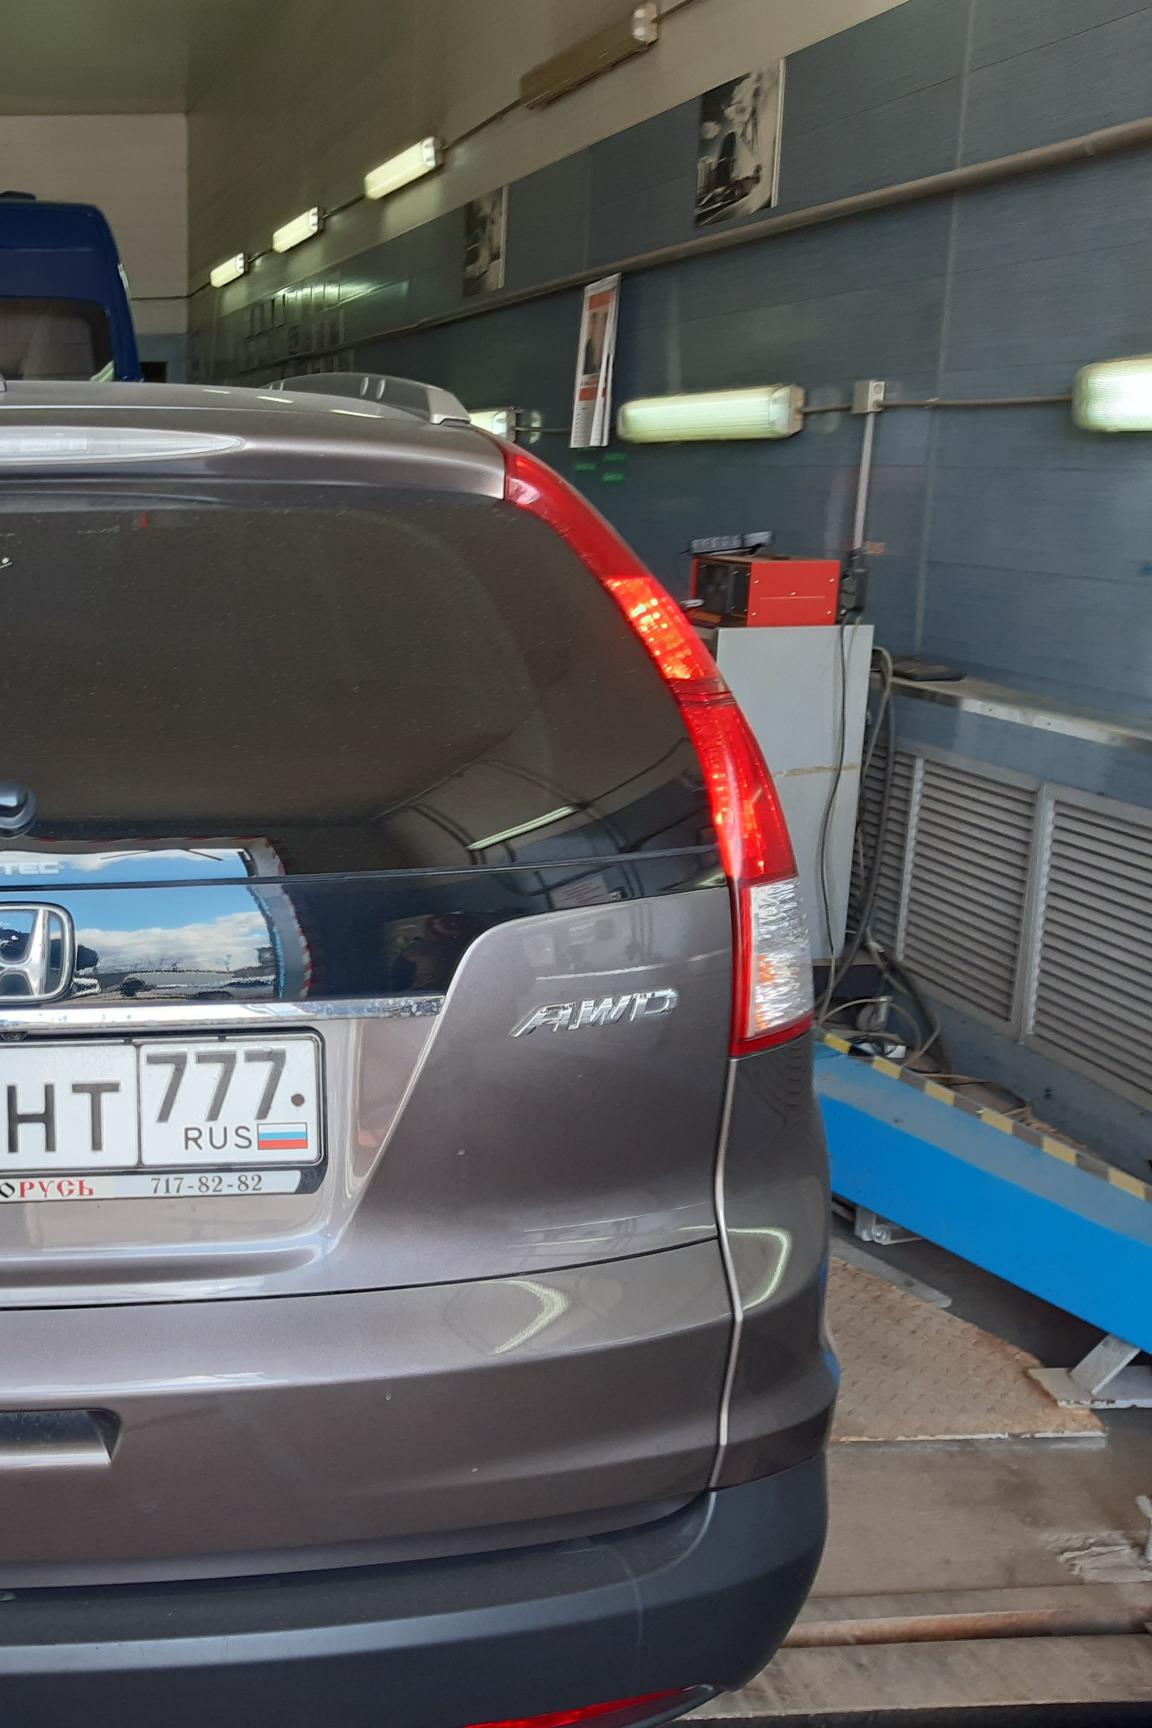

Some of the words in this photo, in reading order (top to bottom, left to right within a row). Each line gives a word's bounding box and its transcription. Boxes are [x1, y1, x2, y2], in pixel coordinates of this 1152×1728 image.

[508, 988, 679, 1038] AWD
[146, 1048, 286, 1123] 777
[184, 1125, 252, 1151] RUS
[150, 1174, 262, 1195] 717-82-82
